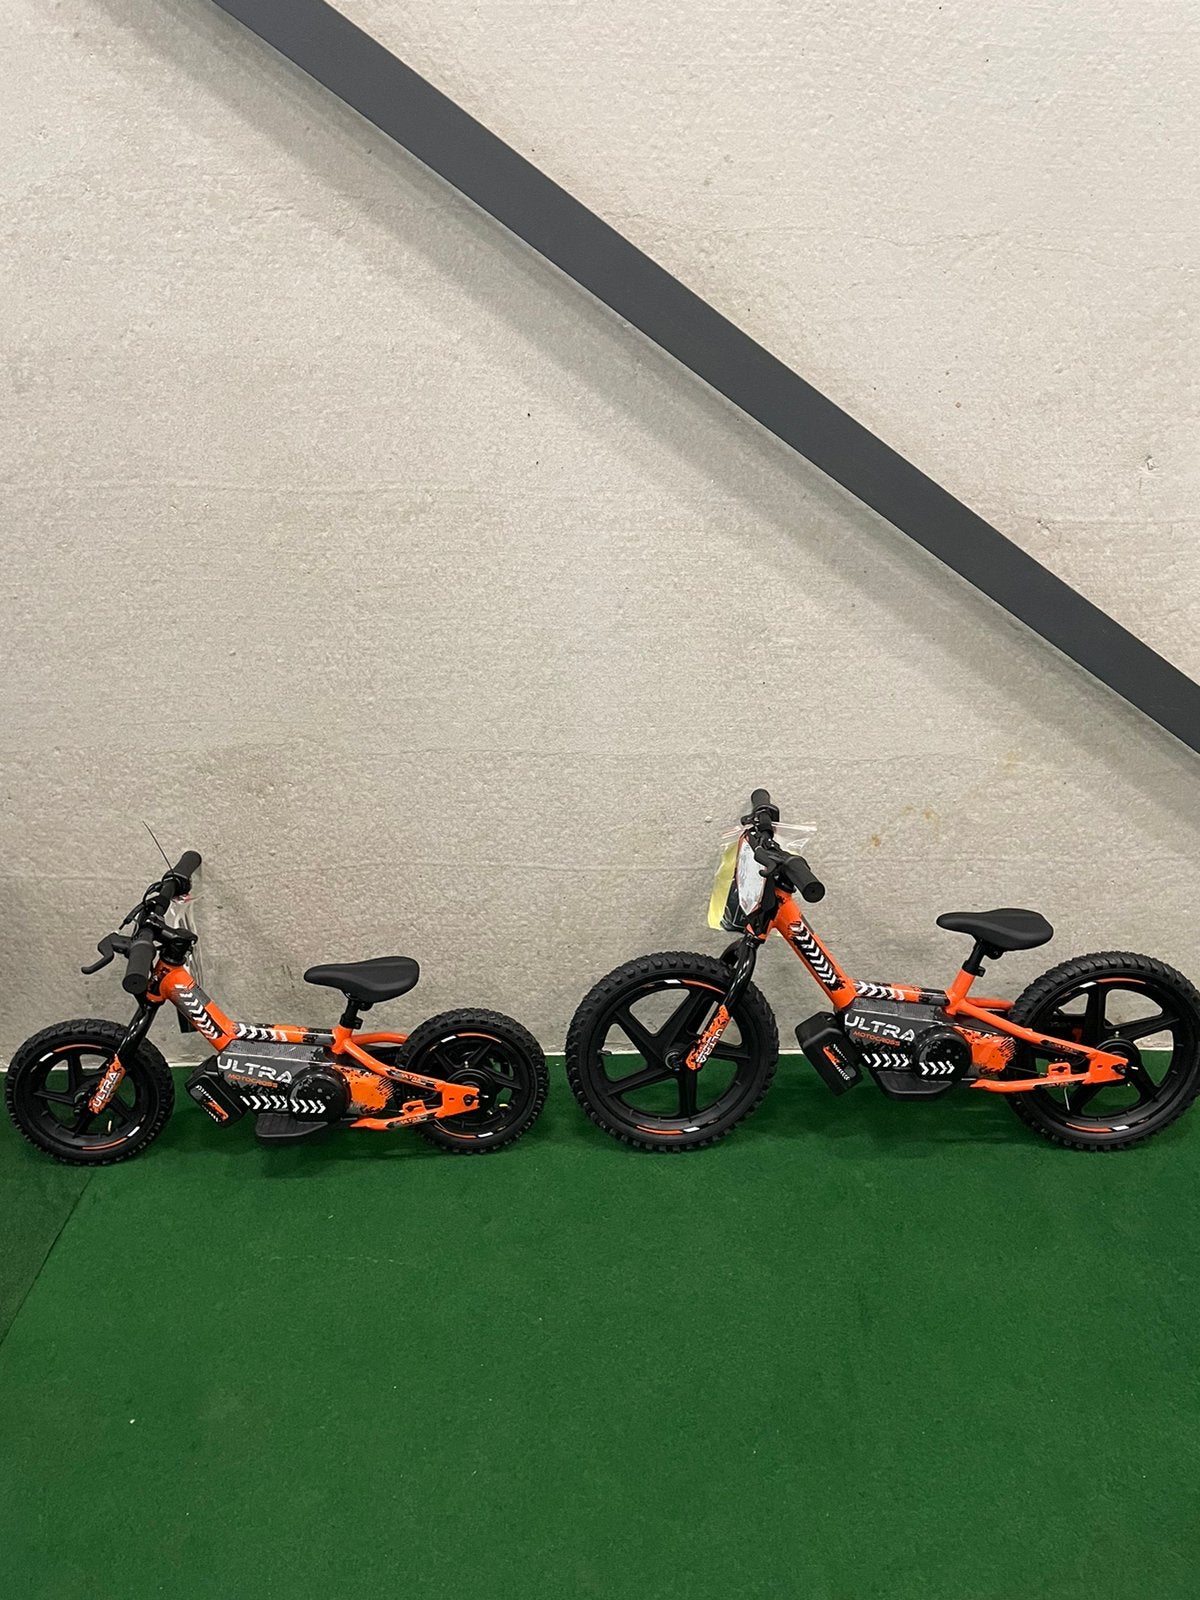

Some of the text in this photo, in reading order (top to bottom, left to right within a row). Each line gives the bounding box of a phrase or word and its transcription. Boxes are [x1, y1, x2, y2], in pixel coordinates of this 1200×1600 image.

[844, 1014, 916, 1041] ULTRA
[853, 1030, 901, 1046] MOTOCROSS
[701, 1029, 723, 1063] ULTRA
[217, 1056, 292, 1084] ULTRA
[227, 1073, 278, 1089] MOTOCROSS
[93, 1072, 118, 1107] ULTRA
